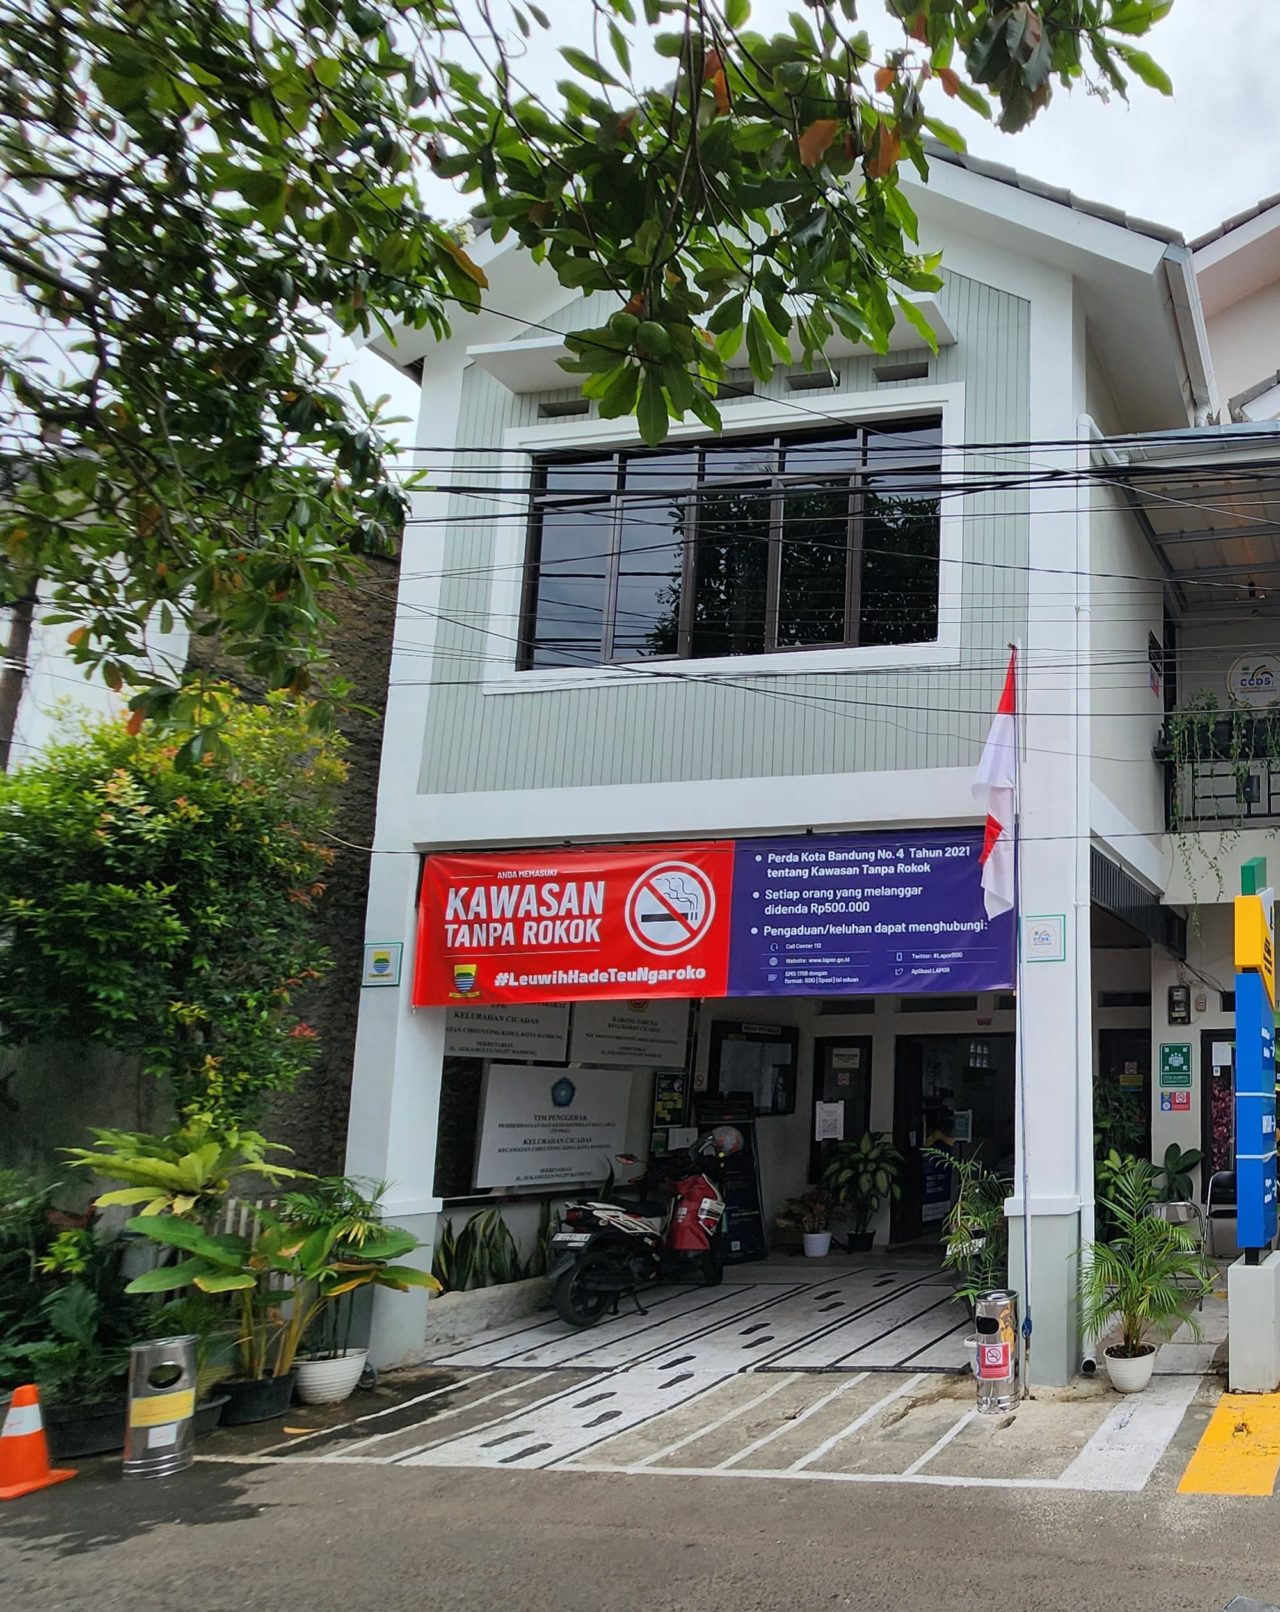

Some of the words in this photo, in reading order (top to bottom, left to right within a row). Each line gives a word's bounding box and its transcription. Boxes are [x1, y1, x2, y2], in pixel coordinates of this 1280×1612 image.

[768, 853, 799, 864] Perda
[801, 851, 826, 862] Kota
[828, 850, 875, 863] Bandung
[909, 847, 943, 858] Tahun
[944, 846, 970, 857] 2021
[497, 871, 516, 879] ANDA
[518, 869, 558, 878] MEMASUKI
[767, 867, 808, 879] tentang
[811, 865, 859, 876] Kawasan
[861, 864, 895, 876] Tanpa
[897, 862, 931, 873] Rokok
[444, 881, 605, 921] KAWASAN
[765, 889, 800, 902] Setiap
[802, 889, 833, 901] orang
[836, 888, 862, 900] yang
[864, 886, 924, 899] melanggar
[765, 904, 808, 915] didenda
[810, 901, 870, 915] Rp500.000
[444, 922, 515, 948] TANPA
[522, 919, 601, 945] ROKOK
[763, 924, 873, 938] Pengaduan/keluhan
[874, 923, 906, 935] dapat
[909, 920, 989, 935] menghubungi:
[495, 965, 706, 987] #LeuwihHadeTeuNgaroko
